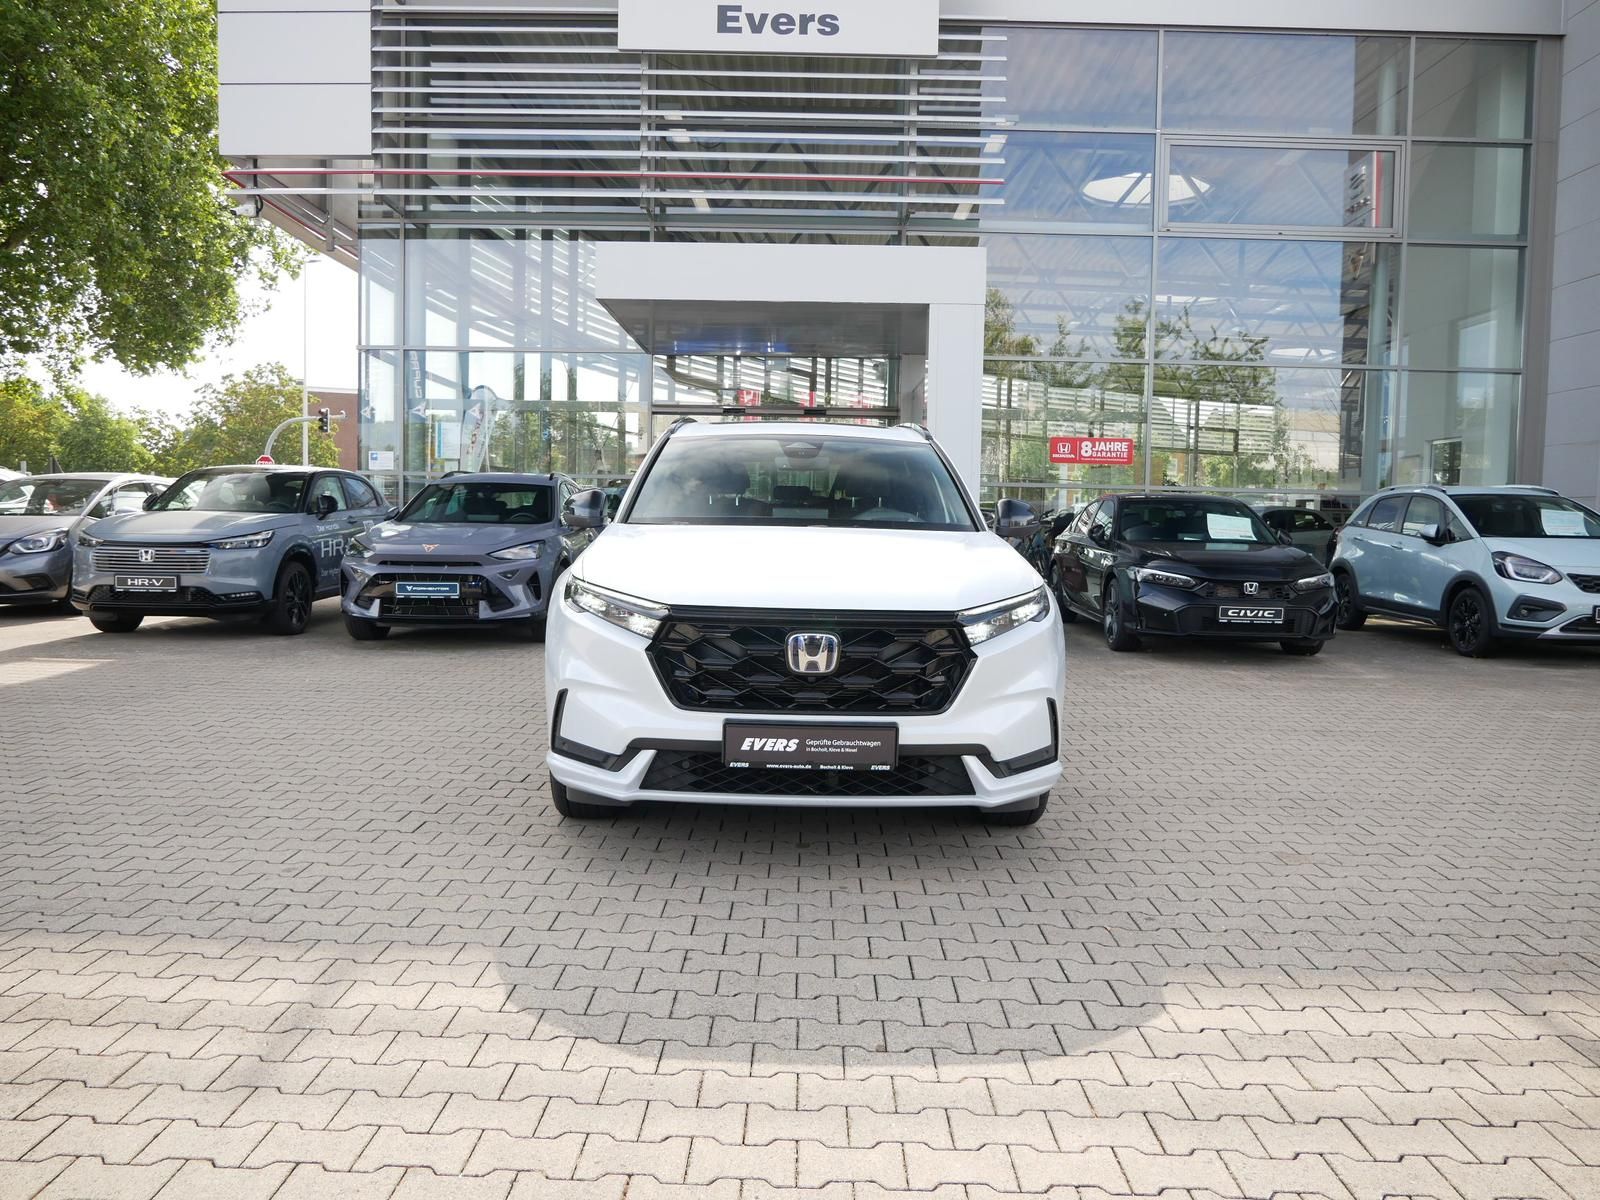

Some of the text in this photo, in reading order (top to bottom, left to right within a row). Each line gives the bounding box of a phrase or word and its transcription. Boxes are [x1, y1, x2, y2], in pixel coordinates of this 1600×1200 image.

[717, 4, 840, 36] Evers
[1081, 441, 1093, 457] 8
[1092, 441, 1129, 452] JAHRE
[127, 578, 163, 586] HR-V
[1227, 609, 1276, 617] CIVIC
[740, 737, 800, 752] EVERS
[805, 738, 882, 747] Geprüfte Gebrauchtwagen
